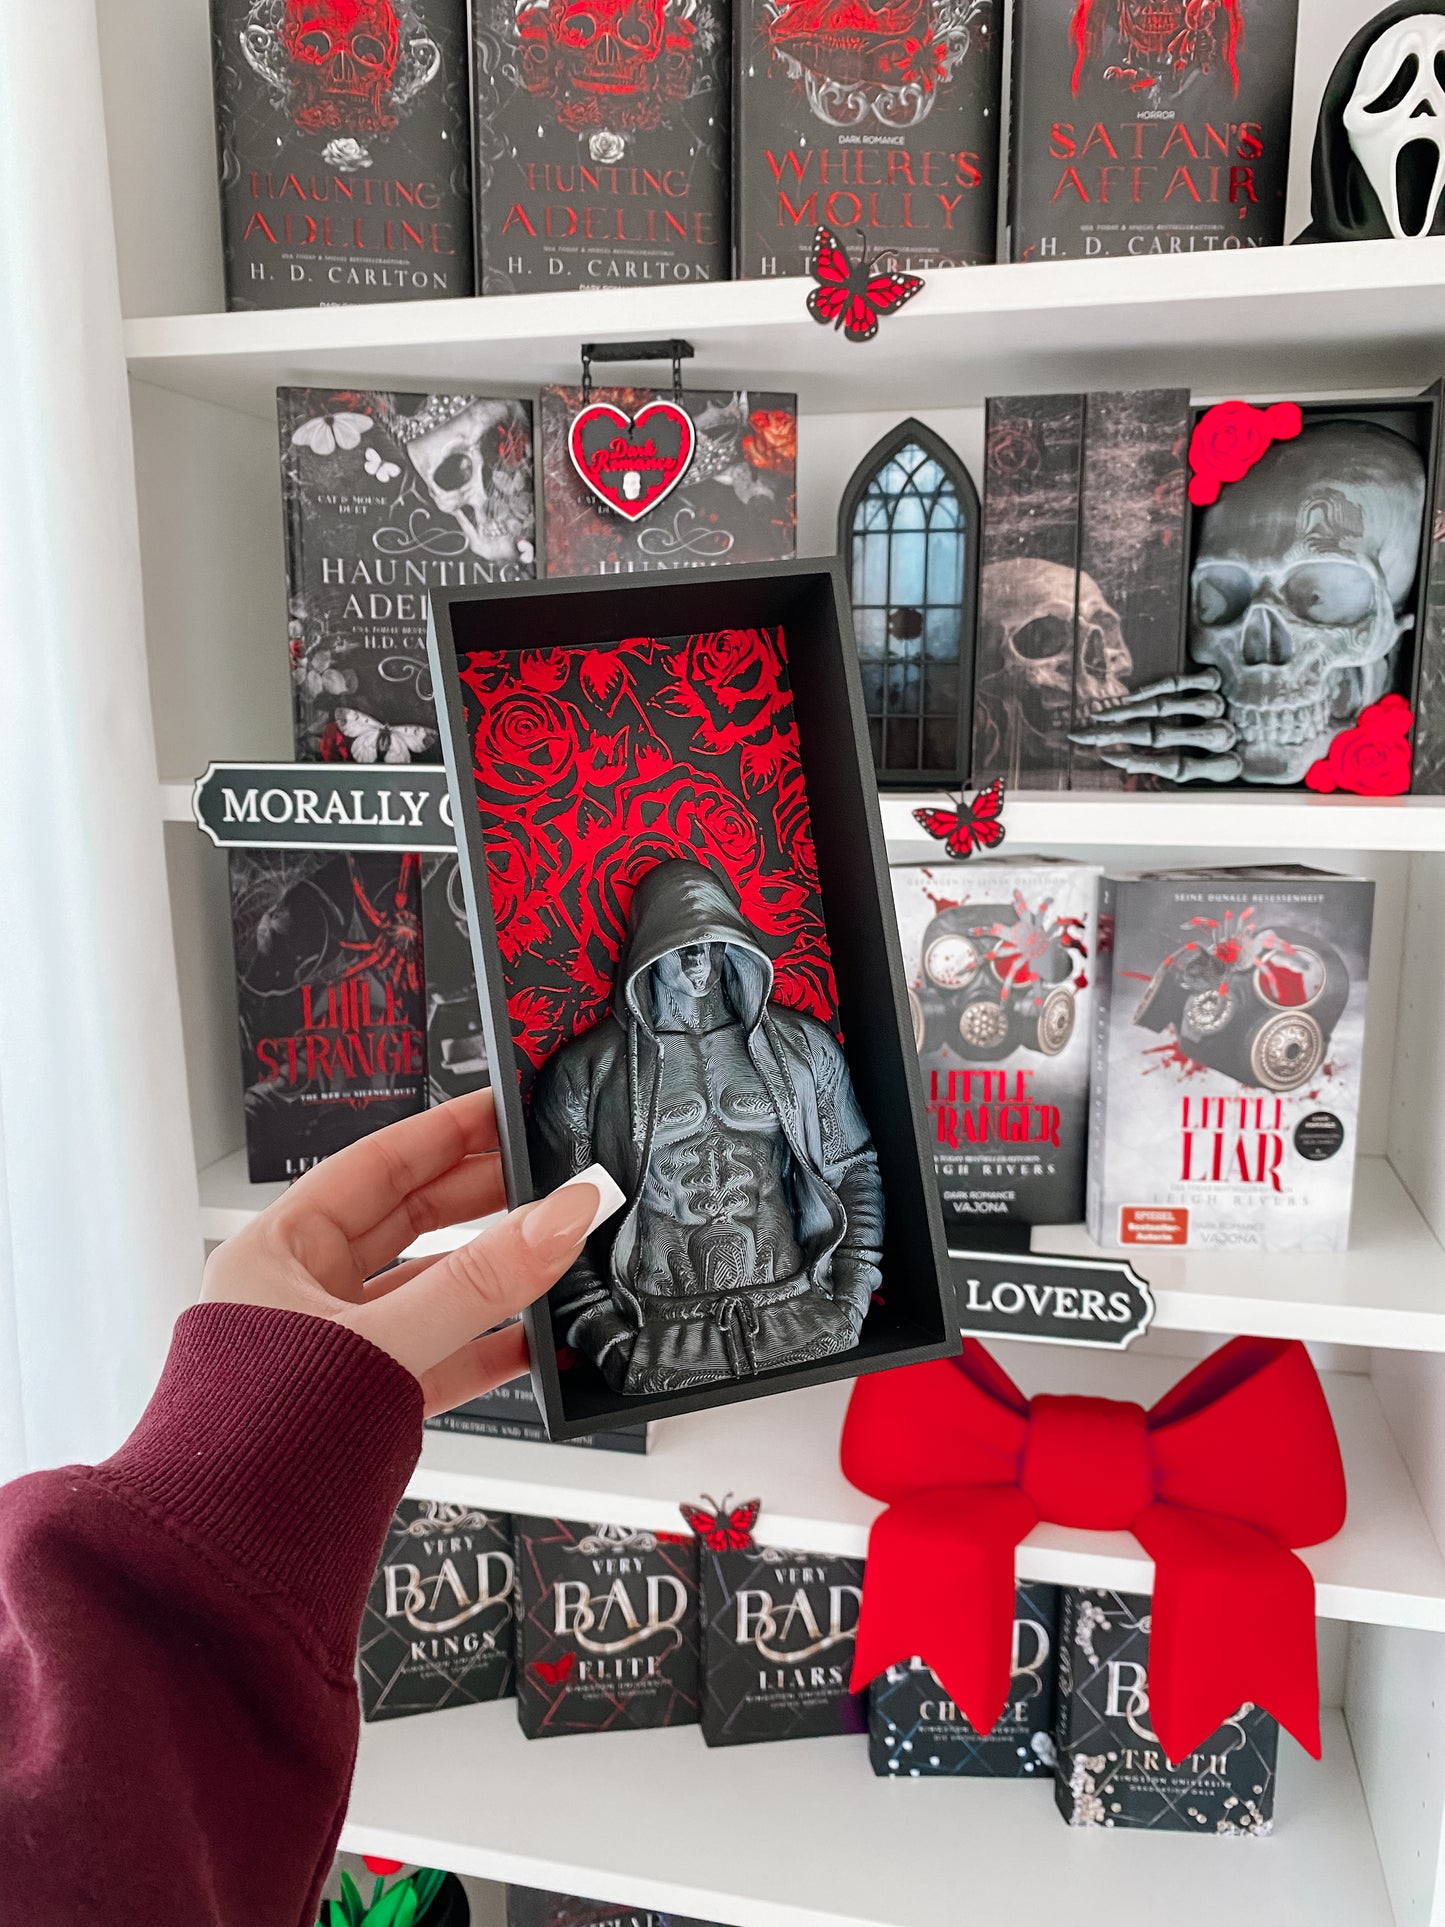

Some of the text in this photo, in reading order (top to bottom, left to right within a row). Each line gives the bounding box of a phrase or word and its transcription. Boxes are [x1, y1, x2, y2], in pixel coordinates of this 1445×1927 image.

[1137, 111, 1175, 119] HORROR
[838, 135, 905, 145] DARK ROMANCE
[1050, 122, 1264, 160] SATAN'S
[528, 163, 690, 197] HUNTING
[764, 149, 982, 188] WHERE'S
[251, 171, 441, 209] HAUNTING
[1050, 165, 1258, 204] AFFAIR
[776, 190, 963, 229] MOLLY
[244, 212, 455, 255] ADELINE
[501, 203, 720, 245] ADELINE
[1040, 237, 1067, 256] H.
[1085, 237, 1109, 256] D.
[250, 263, 447, 289] H. D. CARLTON
[508, 256, 711, 280] H. D. CARLTON
[761, 256, 787, 276] H.
[590, 448, 676, 473] Romance
[610, 437, 657, 458] Dark
[322, 558, 520, 587] HAUNTING
[221, 788, 430, 826] MORALLY
[301, 1092, 318, 1101] THE
[320, 1091, 340, 1100] WEB
[354, 1089, 391, 1098] SILENCE
[394, 1087, 417, 1096] DUET
[930, 1069, 1034, 1103] LITTLE
[1181, 1096, 1290, 1130] LITTLE
[982, 1163, 1057, 1175] RIVERS
[1179, 1131, 1284, 1193] LIAR
[943, 1190, 1016, 1200] DARK ROMANCE
[952, 1201, 1009, 1213] VAJONA
[966, 1280, 1132, 1323] LOVERS
[424, 1536, 474, 1556] VERY
[592, 1557, 644, 1576] VERY
[774, 1566, 828, 1584] VERY
[384, 1551, 515, 1632] BAD
[554, 1575, 688, 1653] BAD
[736, 1585, 863, 1663] BAD
[411, 1632, 496, 1660] KINGS
[579, 1656, 661, 1681] ELITE
[759, 1666, 843, 1690] LIARS
